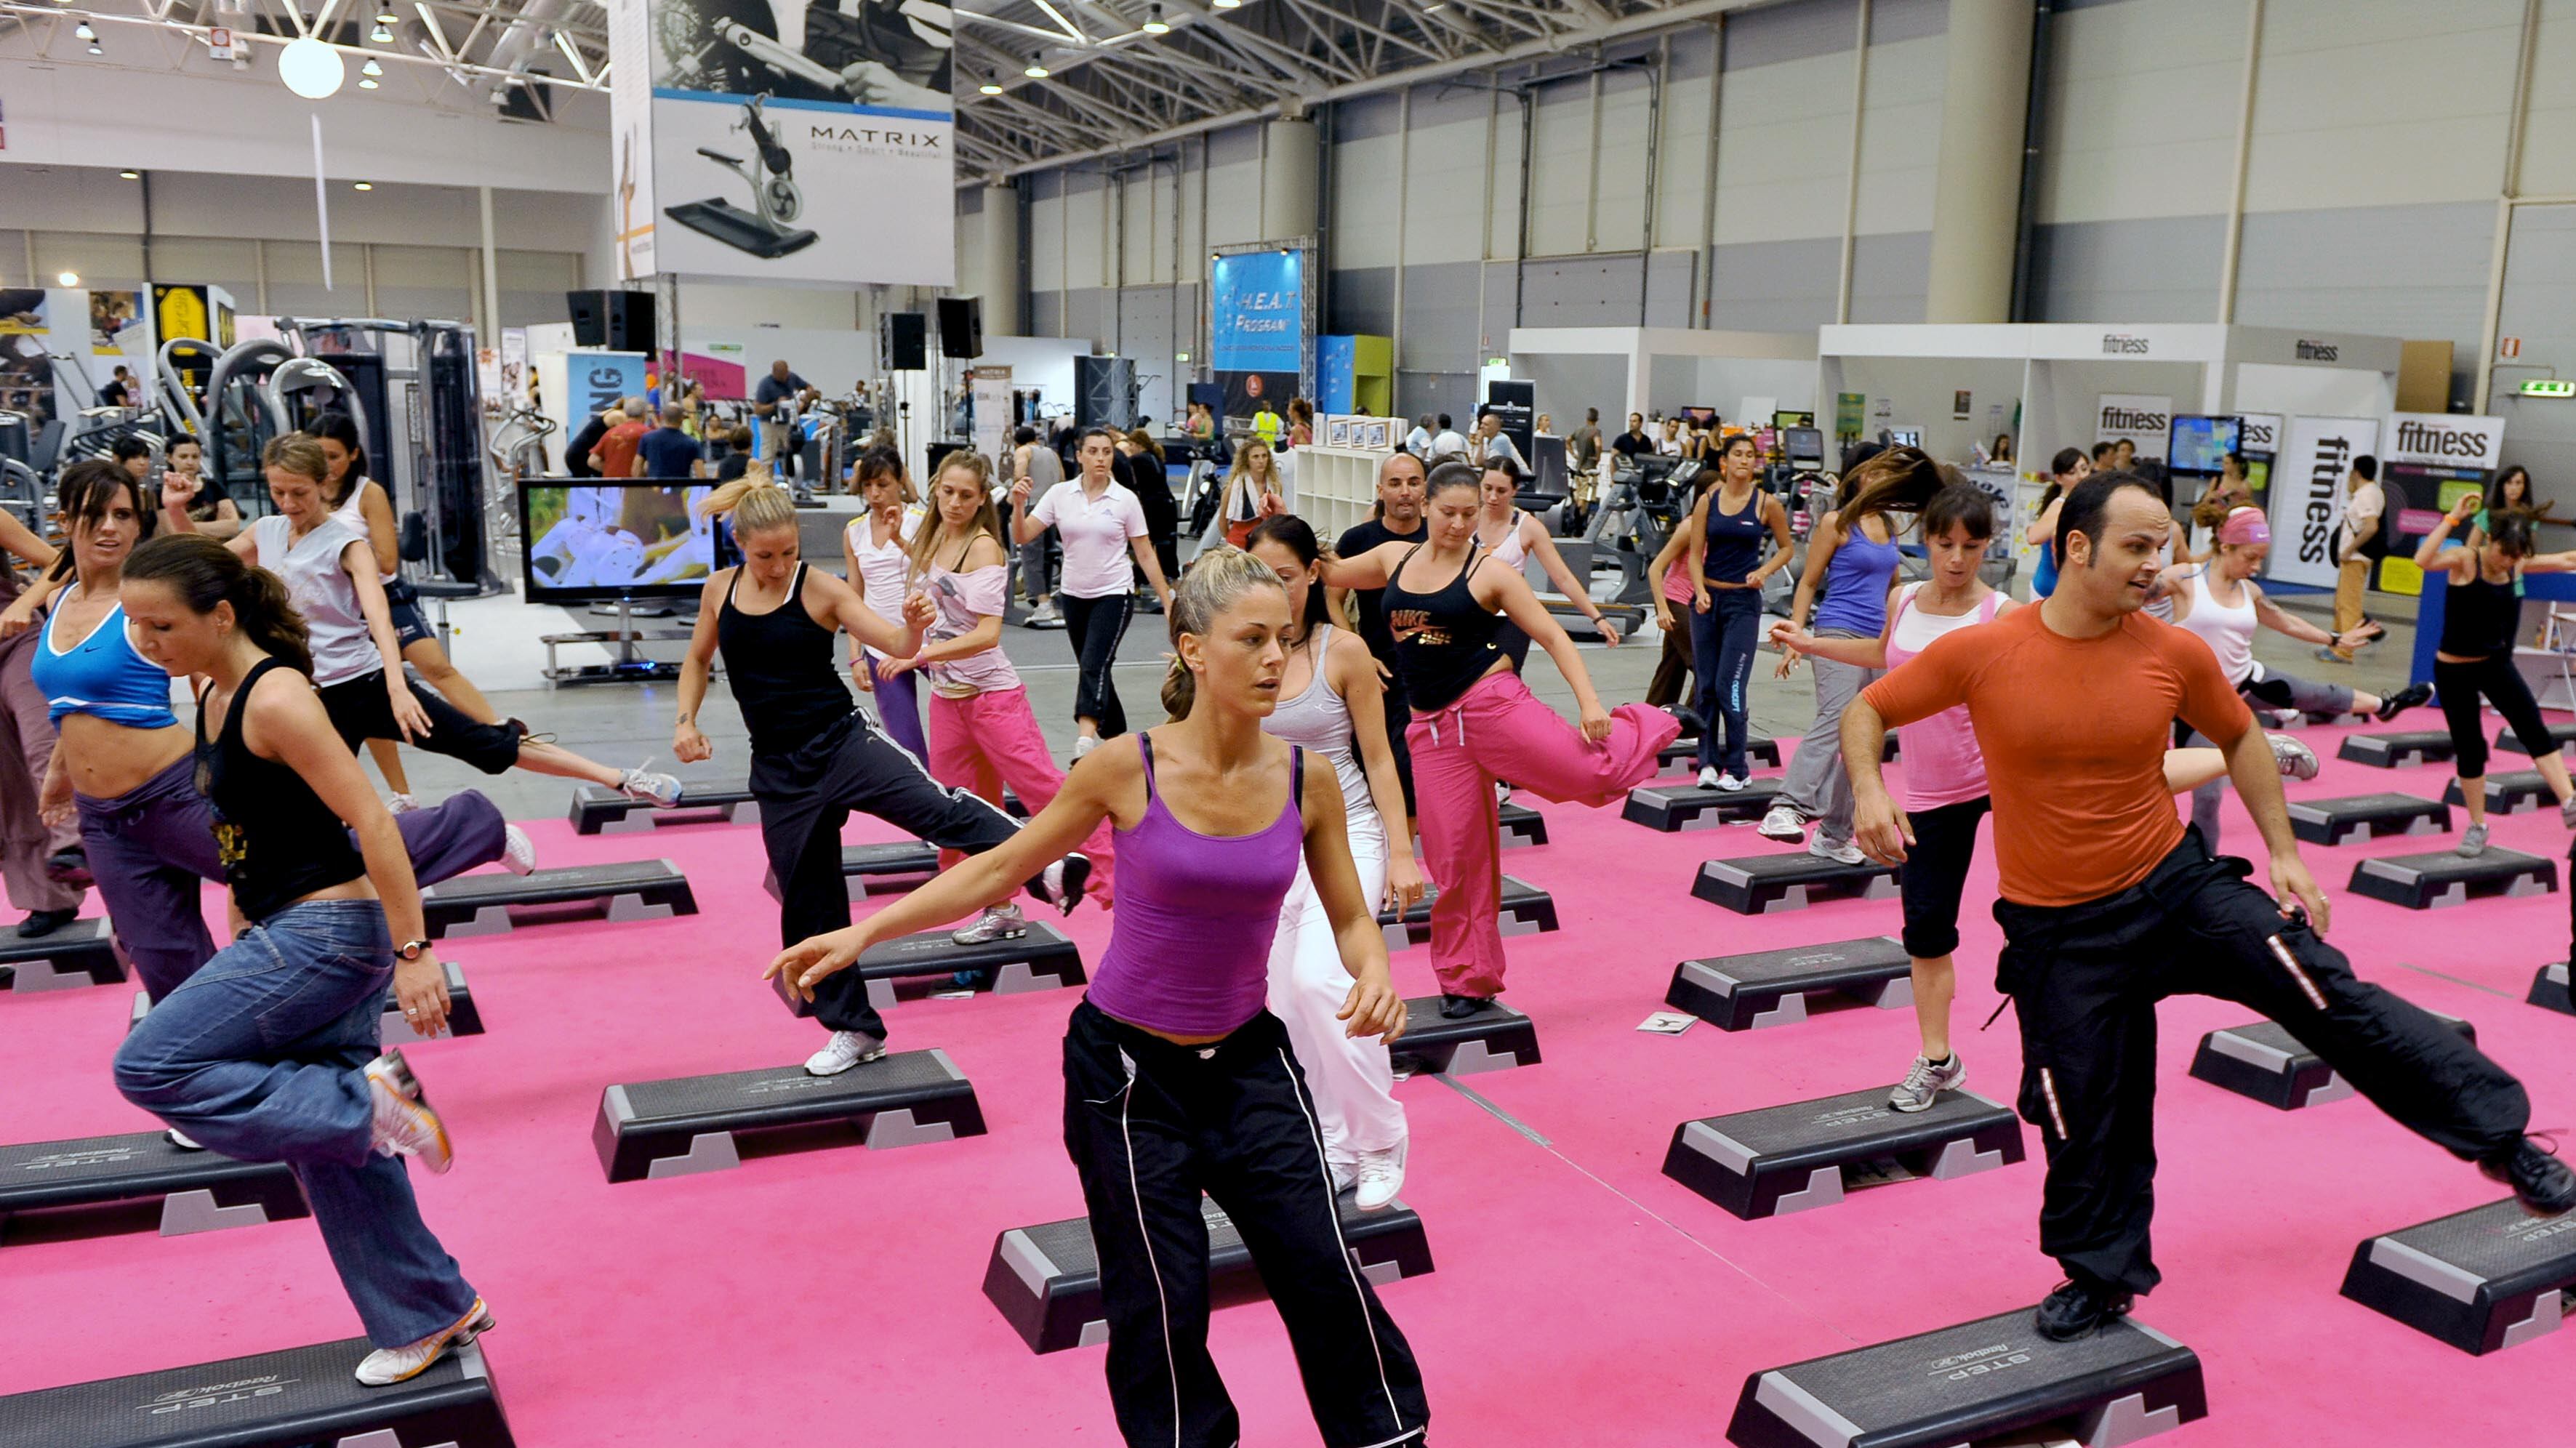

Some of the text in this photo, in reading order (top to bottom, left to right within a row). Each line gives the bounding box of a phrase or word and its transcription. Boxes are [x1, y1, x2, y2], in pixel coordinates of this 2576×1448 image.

[811, 126, 939, 148] MATRIX
[2103, 334, 2148, 353] fitness
[2295, 339, 2338, 361] fitness
[2102, 406, 2166, 430] fitness
[2398, 420, 2487, 457] fitness
[2299, 435, 2349, 563] fitness
[1390, 609, 1431, 627] NIKE
[1731, 680, 1741, 712] CONCEPT
[1826, 1111, 1890, 1127] STEP
[25, 1154, 131, 1170] STEP
[1955, 1343, 2008, 1361] Reebok
[1948, 1354, 2031, 1380] STEP
[198, 1375, 278, 1393] Reebok
[151, 1385, 283, 1415] STEP
